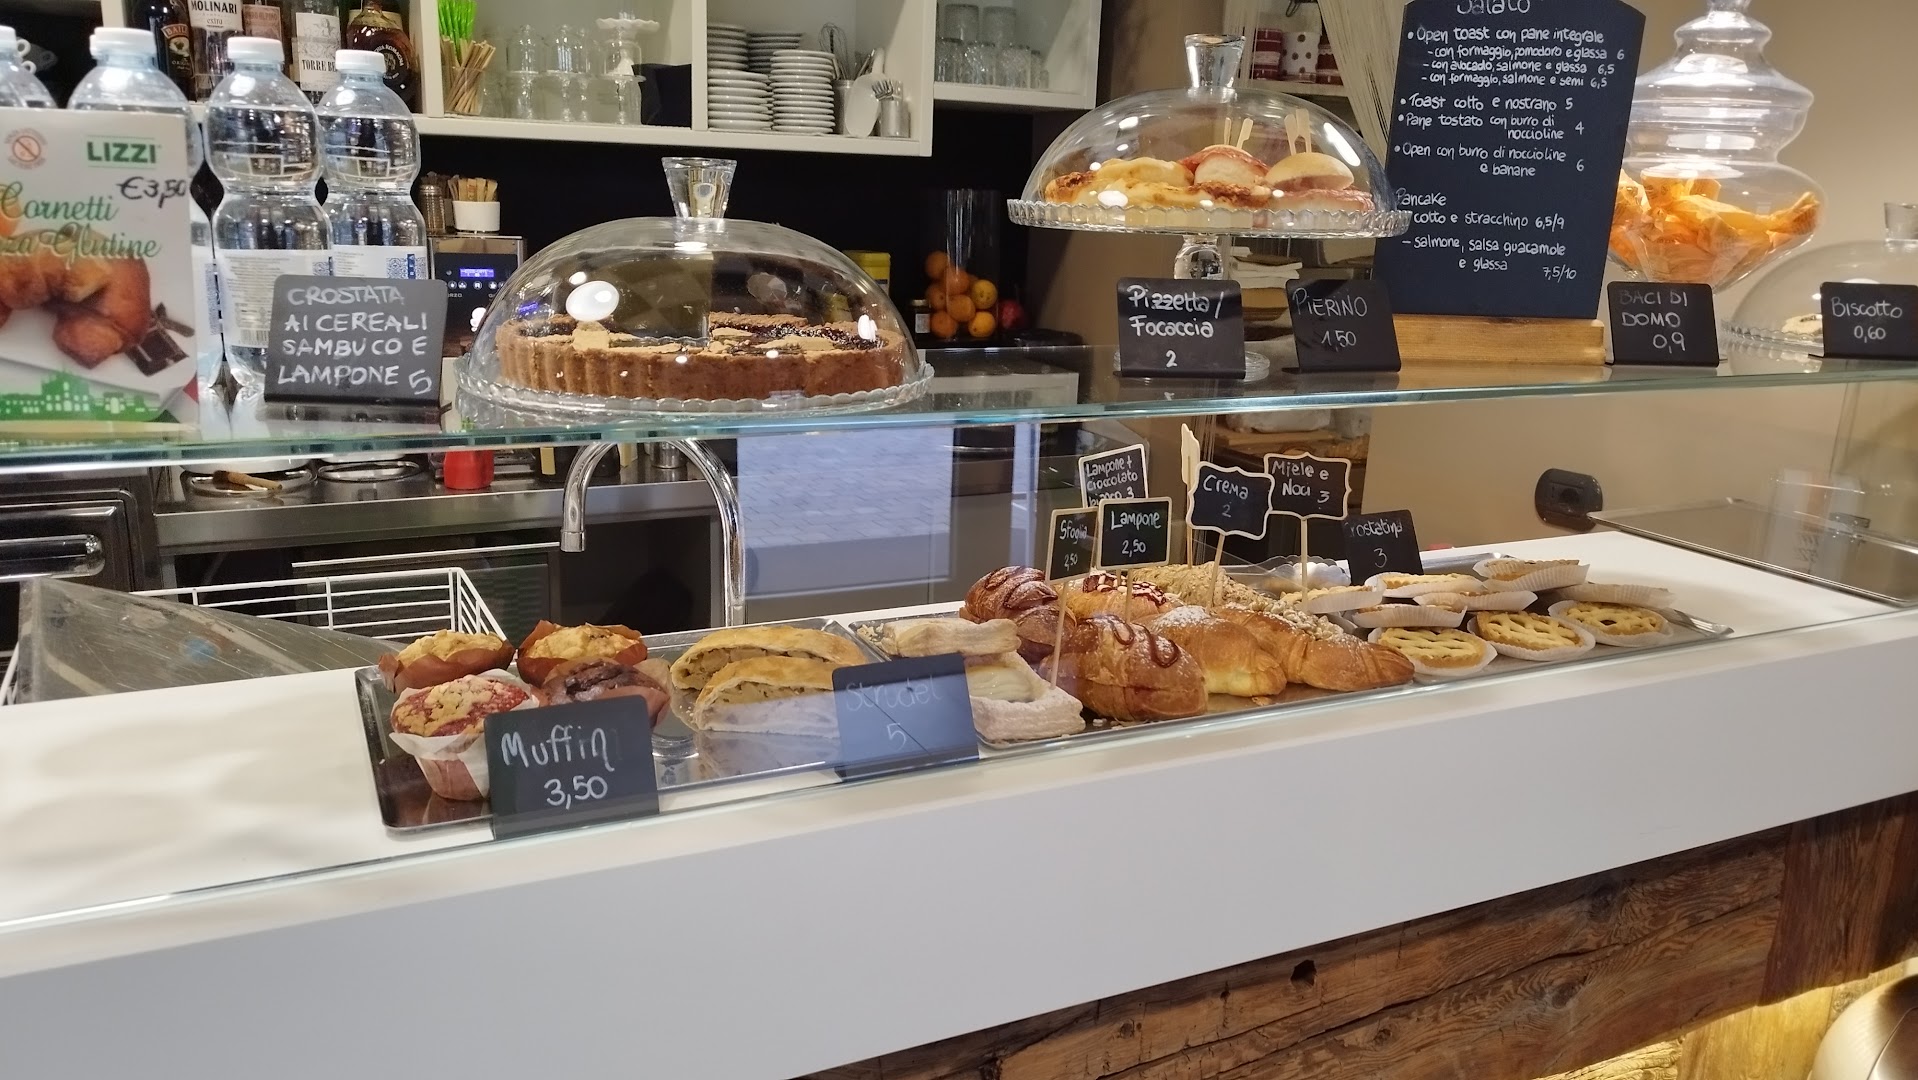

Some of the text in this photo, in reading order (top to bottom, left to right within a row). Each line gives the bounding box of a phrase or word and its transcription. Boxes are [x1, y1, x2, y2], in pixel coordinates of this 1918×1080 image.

[191, 0, 237, 14] MOLINARI
[1416, 25, 1604, 46] Open toast con pane integrale
[1434, 47, 1454, 59] con
[1574, 47, 1607, 62] glassa
[1616, 49, 1625, 60] 6
[302, 59, 327, 71] TORRE
[1431, 60, 1449, 73] con
[1496, 61, 1541, 72] salmone
[1545, 62, 1552, 70] e
[1555, 61, 1588, 74] glassa
[1598, 64, 1615, 75] 6,5
[1429, 73, 1446, 86] con
[1502, 72, 1546, 85] salmone
[1549, 76, 1556, 84] e
[1559, 76, 1584, 86] semi
[1590, 77, 1608, 89] 6,5
[1409, 93, 1574, 111] Toast cotto e nostrano 5
[1405, 114, 1555, 130] Pane tostato con burro di
[1575, 121, 1585, 135] 4
[1507, 127, 1565, 140] noccioline
[87, 142, 156, 163] LIZZI
[1402, 142, 1567, 162] Open con burro di noccioline
[1480, 163, 1536, 177] e banane
[1576, 159, 1585, 172] 6
[0, 181, 120, 222] Cornetti
[116, 176, 188, 208] €3,50
[1413, 210, 1565, 233] cotto e stracchino 6,5/9
[38, 222, 162, 262] Glutine
[1469, 238, 1499, 252] salsa
[1503, 240, 1567, 257] guacamole
[1458, 258, 1508, 273] e glassa
[1543, 265, 1577, 283] 7,5/10
[287, 285, 405, 305] CROSTATA
[1620, 289, 1688, 307] BACI DI
[1831, 297, 1903, 318] Biscotto
[284, 312, 427, 332] AI CEREALI
[1128, 315, 1214, 338] Focaccia
[1622, 311, 1681, 328] DOMO
[1321, 330, 1357, 352] 1,50
[1652, 331, 1686, 354] 0,9
[1853, 325, 1887, 343] 0,60
[412, 336, 428, 356] E
[1165, 350, 1178, 368] 2
[277, 365, 432, 395] LAMPONE 5
[1086, 470, 1138, 491] cioccolato
[1271, 461, 1330, 480] Miele e
[1203, 474, 1249, 499] Crema
[1282, 479, 1330, 503] Noci 3
[1110, 510, 1162, 530] Lampone
[1221, 504, 1231, 518] 2
[1344, 518, 1403, 538] rostatina
[1121, 539, 1147, 557] 2,50
[1373, 548, 1388, 568] 3
[1064, 552, 1078, 571] 2,50
[886, 722, 907, 751] 5
[501, 724, 615, 772] Muffin
[543, 775, 608, 810] 3,50
